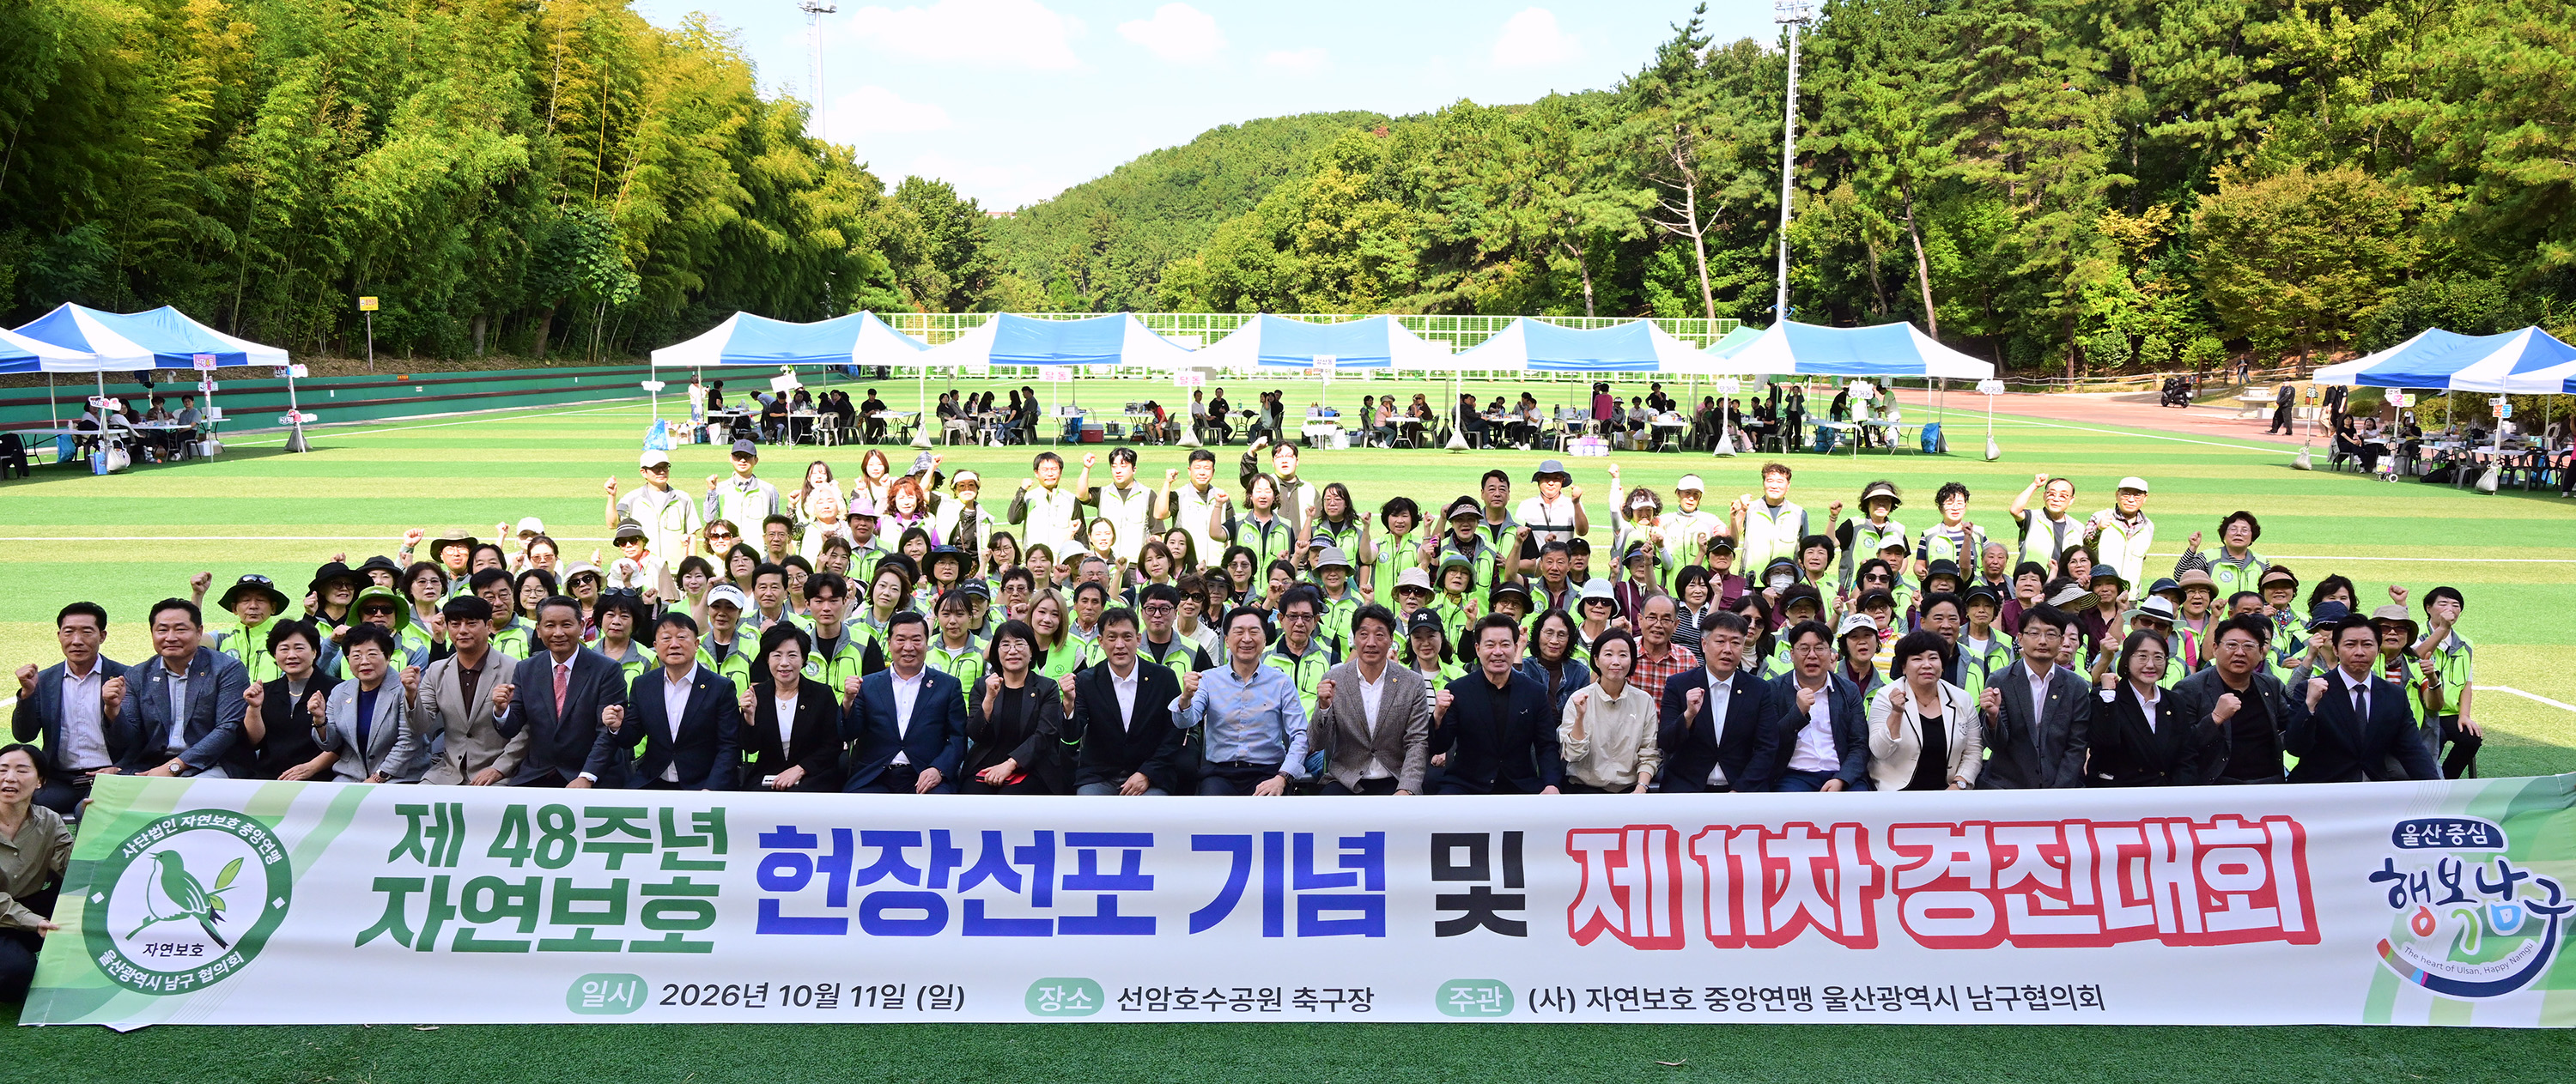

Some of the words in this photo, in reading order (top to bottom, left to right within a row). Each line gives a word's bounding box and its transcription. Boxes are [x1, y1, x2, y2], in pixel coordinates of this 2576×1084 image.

[122, 818, 178, 859] 사단법인
[180, 814, 241, 830] 자연보호
[238, 821, 283, 865] 중앙연맹
[388, 802, 465, 868] 제
[488, 804, 728, 871] 48주년
[2401, 823, 2442, 846] 울산
[2445, 823, 2488, 846] 중심
[756, 826, 1157, 937] 헌장선포
[1189, 831, 1387, 937] 기념
[1431, 831, 1528, 937] 및
[1888, 814, 2321, 950] 경진대회
[354, 875, 720, 954] 자연보호
[2368, 857, 2479, 951] 행복
[143, 942, 204, 957] 자연보호
[2404, 947, 2419, 960] The
[2421, 955, 2444, 970] heart
[2457, 966, 2482, 975] Ulsan,
[2484, 962, 2509, 974] Happy
[2509, 942, 2534, 965] Namgu
[97, 949, 162, 990] 울산광역시
[164, 972, 195, 990] 남구
[197, 950, 246, 984] 협의회
[581, 981, 637, 1008] 일시
[660, 983, 769, 1008] 2026년
[780, 983, 841, 1008] 10월
[851, 984, 906, 1008] 11일
[917, 984, 965, 1011] (일)
[1037, 985, 1093, 1012] 장소
[1117, 986, 1282, 1012] 선암호수공원
[1292, 986, 1374, 1012] 축구장
[1449, 986, 1504, 1012] 주관
[1528, 985, 1575, 1014] (사)
[1586, 986, 1697, 1012] 자연보호
[1704, 986, 1814, 1012] 중앙연맹
[1822, 985, 1959, 1012] 울산광역시
[1967, 984, 2105, 1012] 남구협의회
